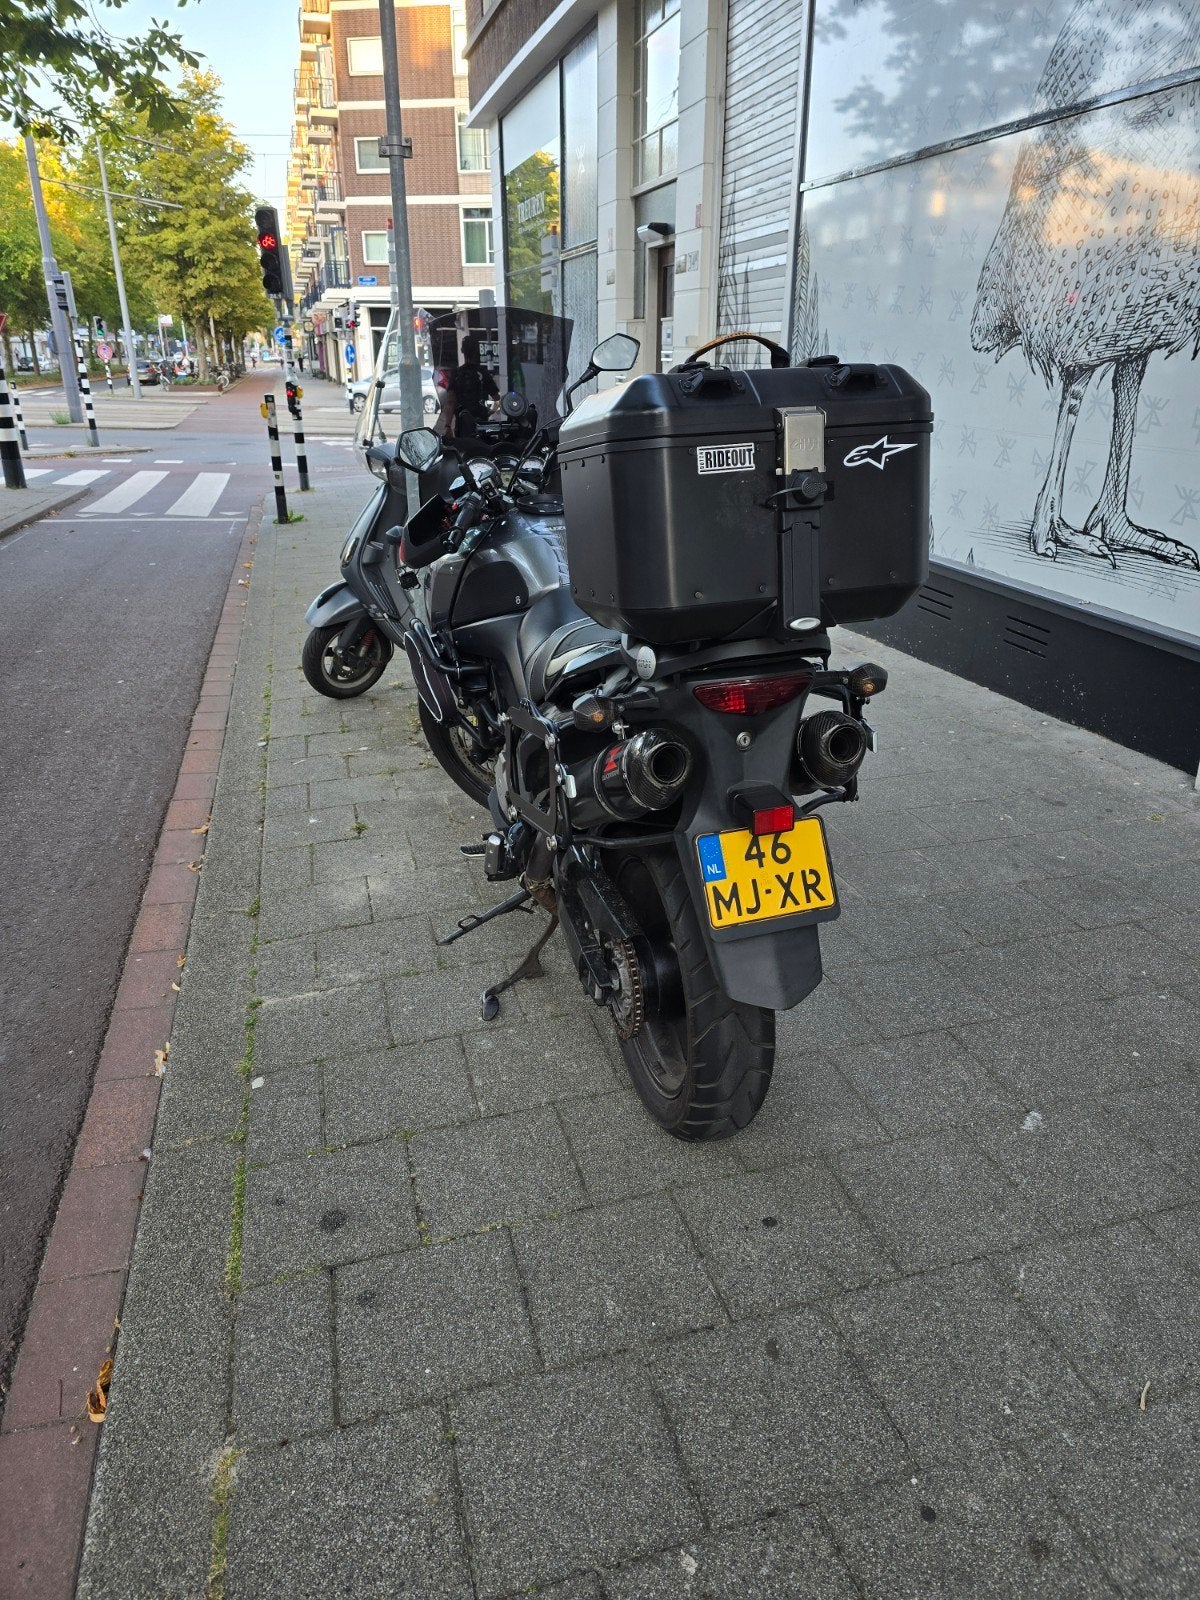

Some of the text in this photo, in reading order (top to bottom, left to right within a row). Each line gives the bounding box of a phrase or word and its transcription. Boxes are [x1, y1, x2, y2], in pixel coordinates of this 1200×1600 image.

[704, 447, 753, 469] RIDEOUT
[744, 831, 792, 869] 46
[706, 863, 722, 876] NL
[712, 868, 826, 921] MJ-XR
